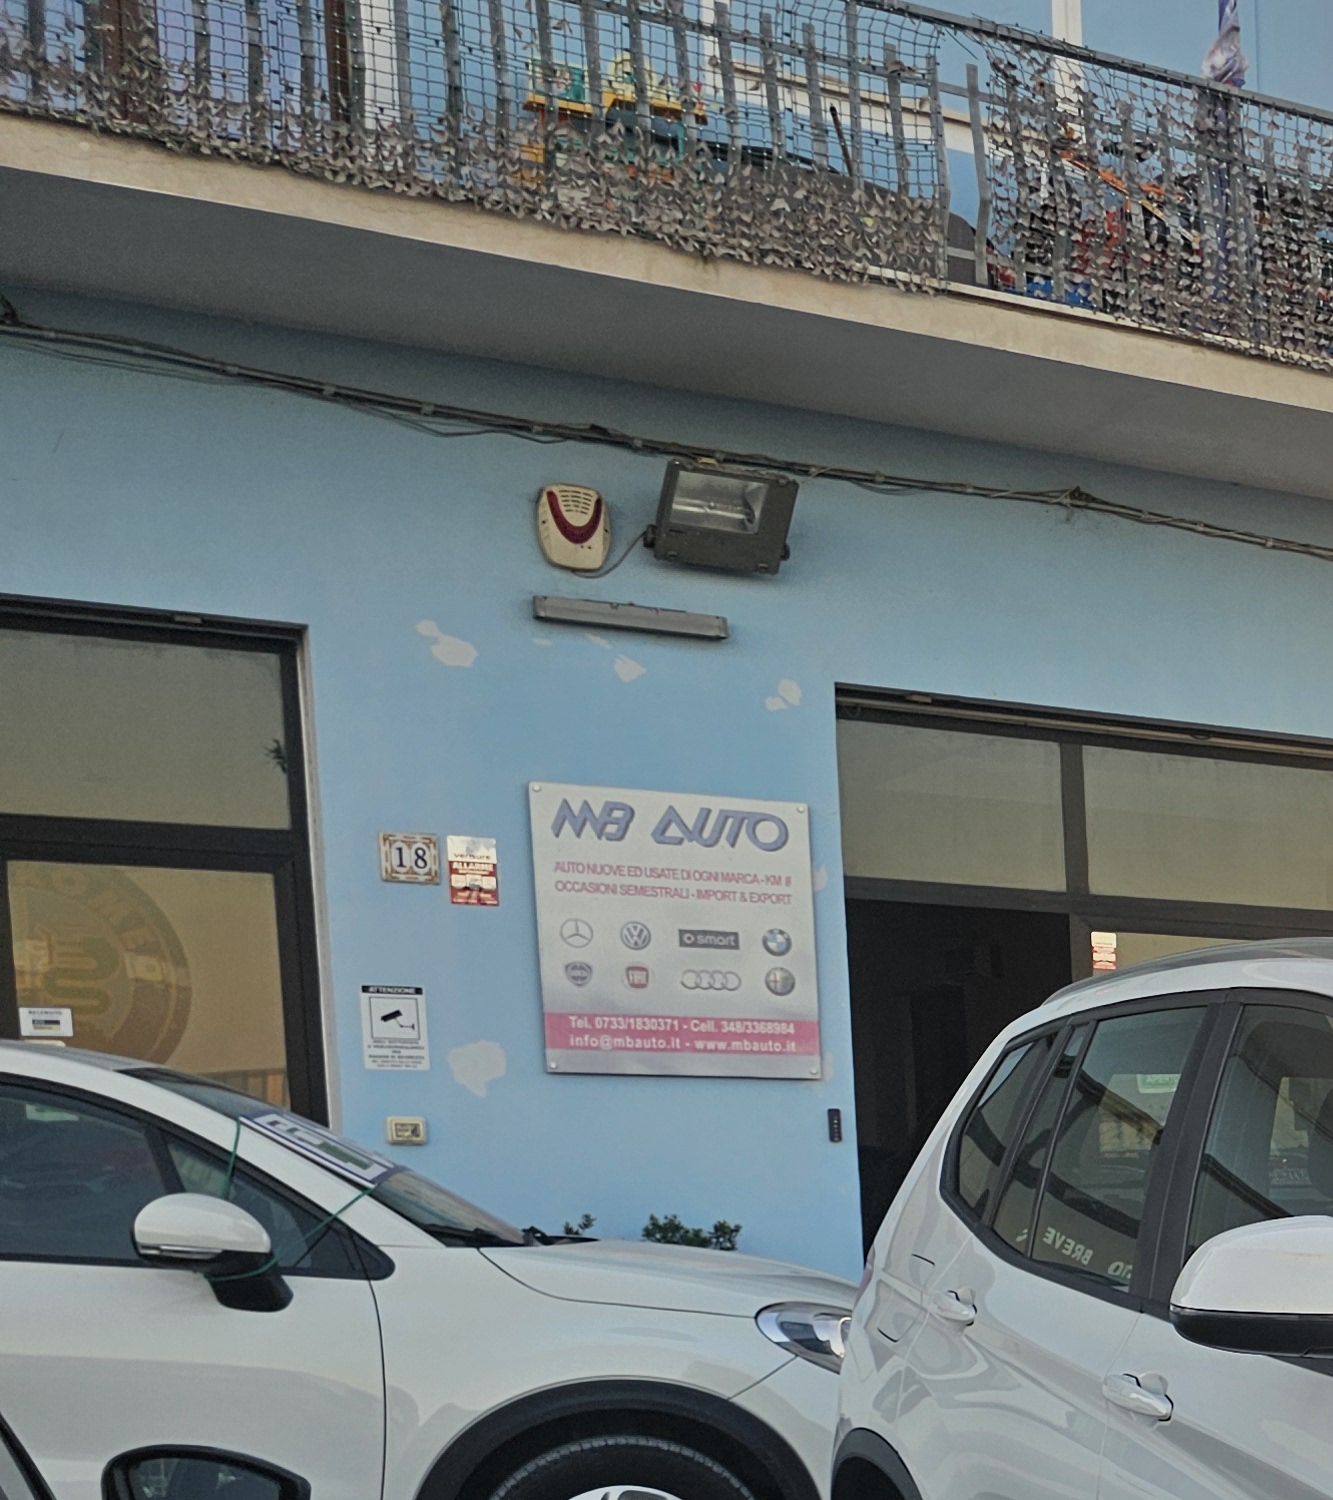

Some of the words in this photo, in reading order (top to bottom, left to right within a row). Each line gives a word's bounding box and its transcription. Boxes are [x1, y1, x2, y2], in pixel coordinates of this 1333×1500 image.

[551, 798, 635, 842] MB
[651, 804, 789, 852] AUTO
[396, 847, 428, 869] 18
[554, 861, 585, 874] AUTO
[586, 862, 626, 877] NUOVE
[627, 865, 643, 878] ED
[644, 867, 680, 880] USATE
[693, 870, 719, 882] OGNI
[720, 871, 760, 885] MARCA
[554, 880, 618, 895] OCCASIONI
[620, 883, 690, 899] SEMESTRALI
[696, 888, 738, 902] IMPORT
[749, 892, 793, 905] EXPORT
[697, 934, 736, 947] smart
[568, 1015, 592, 1029] Tel.
[690, 1019, 718, 1033] Cell.
[569, 1033, 681, 1051] info@mbauto.it
[694, 1039, 797, 1053] www.mbauto.it
